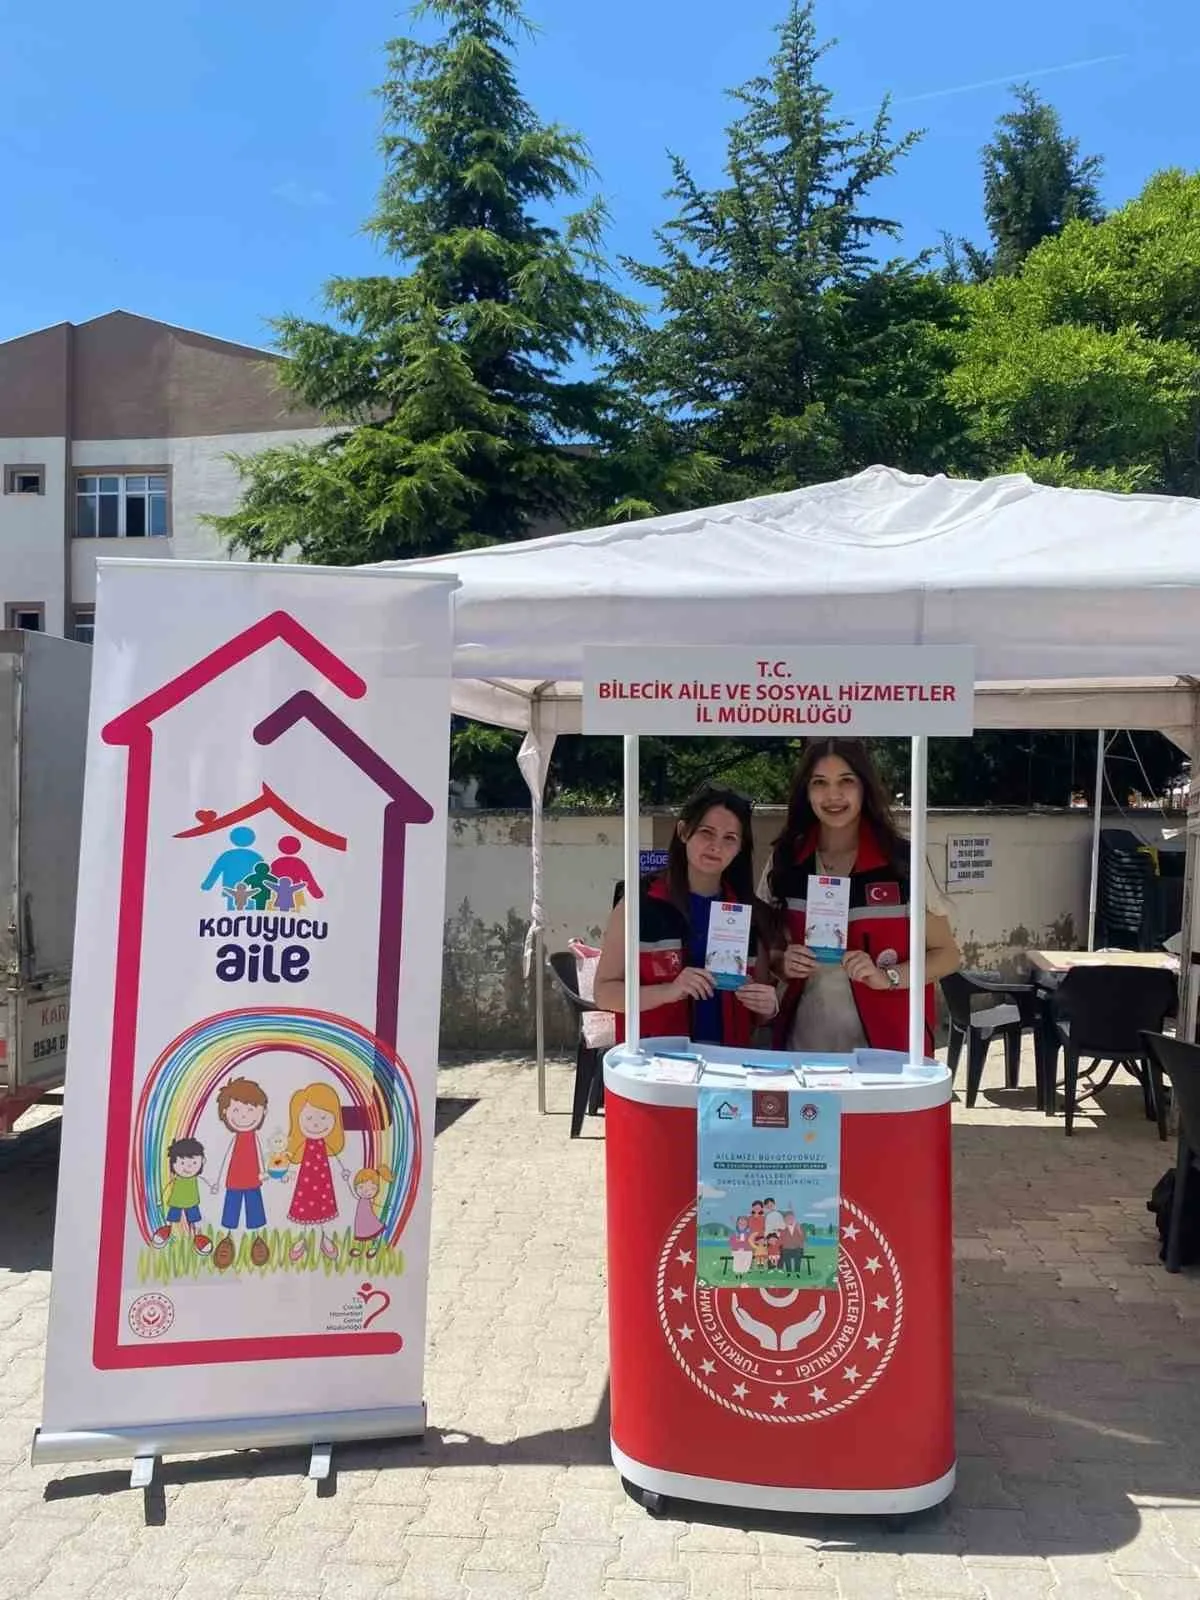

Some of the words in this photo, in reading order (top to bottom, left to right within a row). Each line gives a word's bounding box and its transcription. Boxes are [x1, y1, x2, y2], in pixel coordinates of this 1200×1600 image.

[757, 661, 792, 678] T.C.
[598, 679, 674, 700] BİLECİK
[678, 680, 721, 700] AİLE
[726, 684, 751, 701] VE
[756, 683, 832, 701] SOSYAL
[838, 681, 956, 702] HİZMETLER
[696, 703, 713, 723] İL
[718, 703, 852, 724] MÜDÜRLÜĞÜ
[640, 852, 669, 866] ÇİĞDE
[215, 943, 310, 983] aile
[41, 1004, 68, 1026] KAR
[699, 1287, 717, 1332] CUMH
[795, 1324, 856, 1378] BAKANLIĞI
